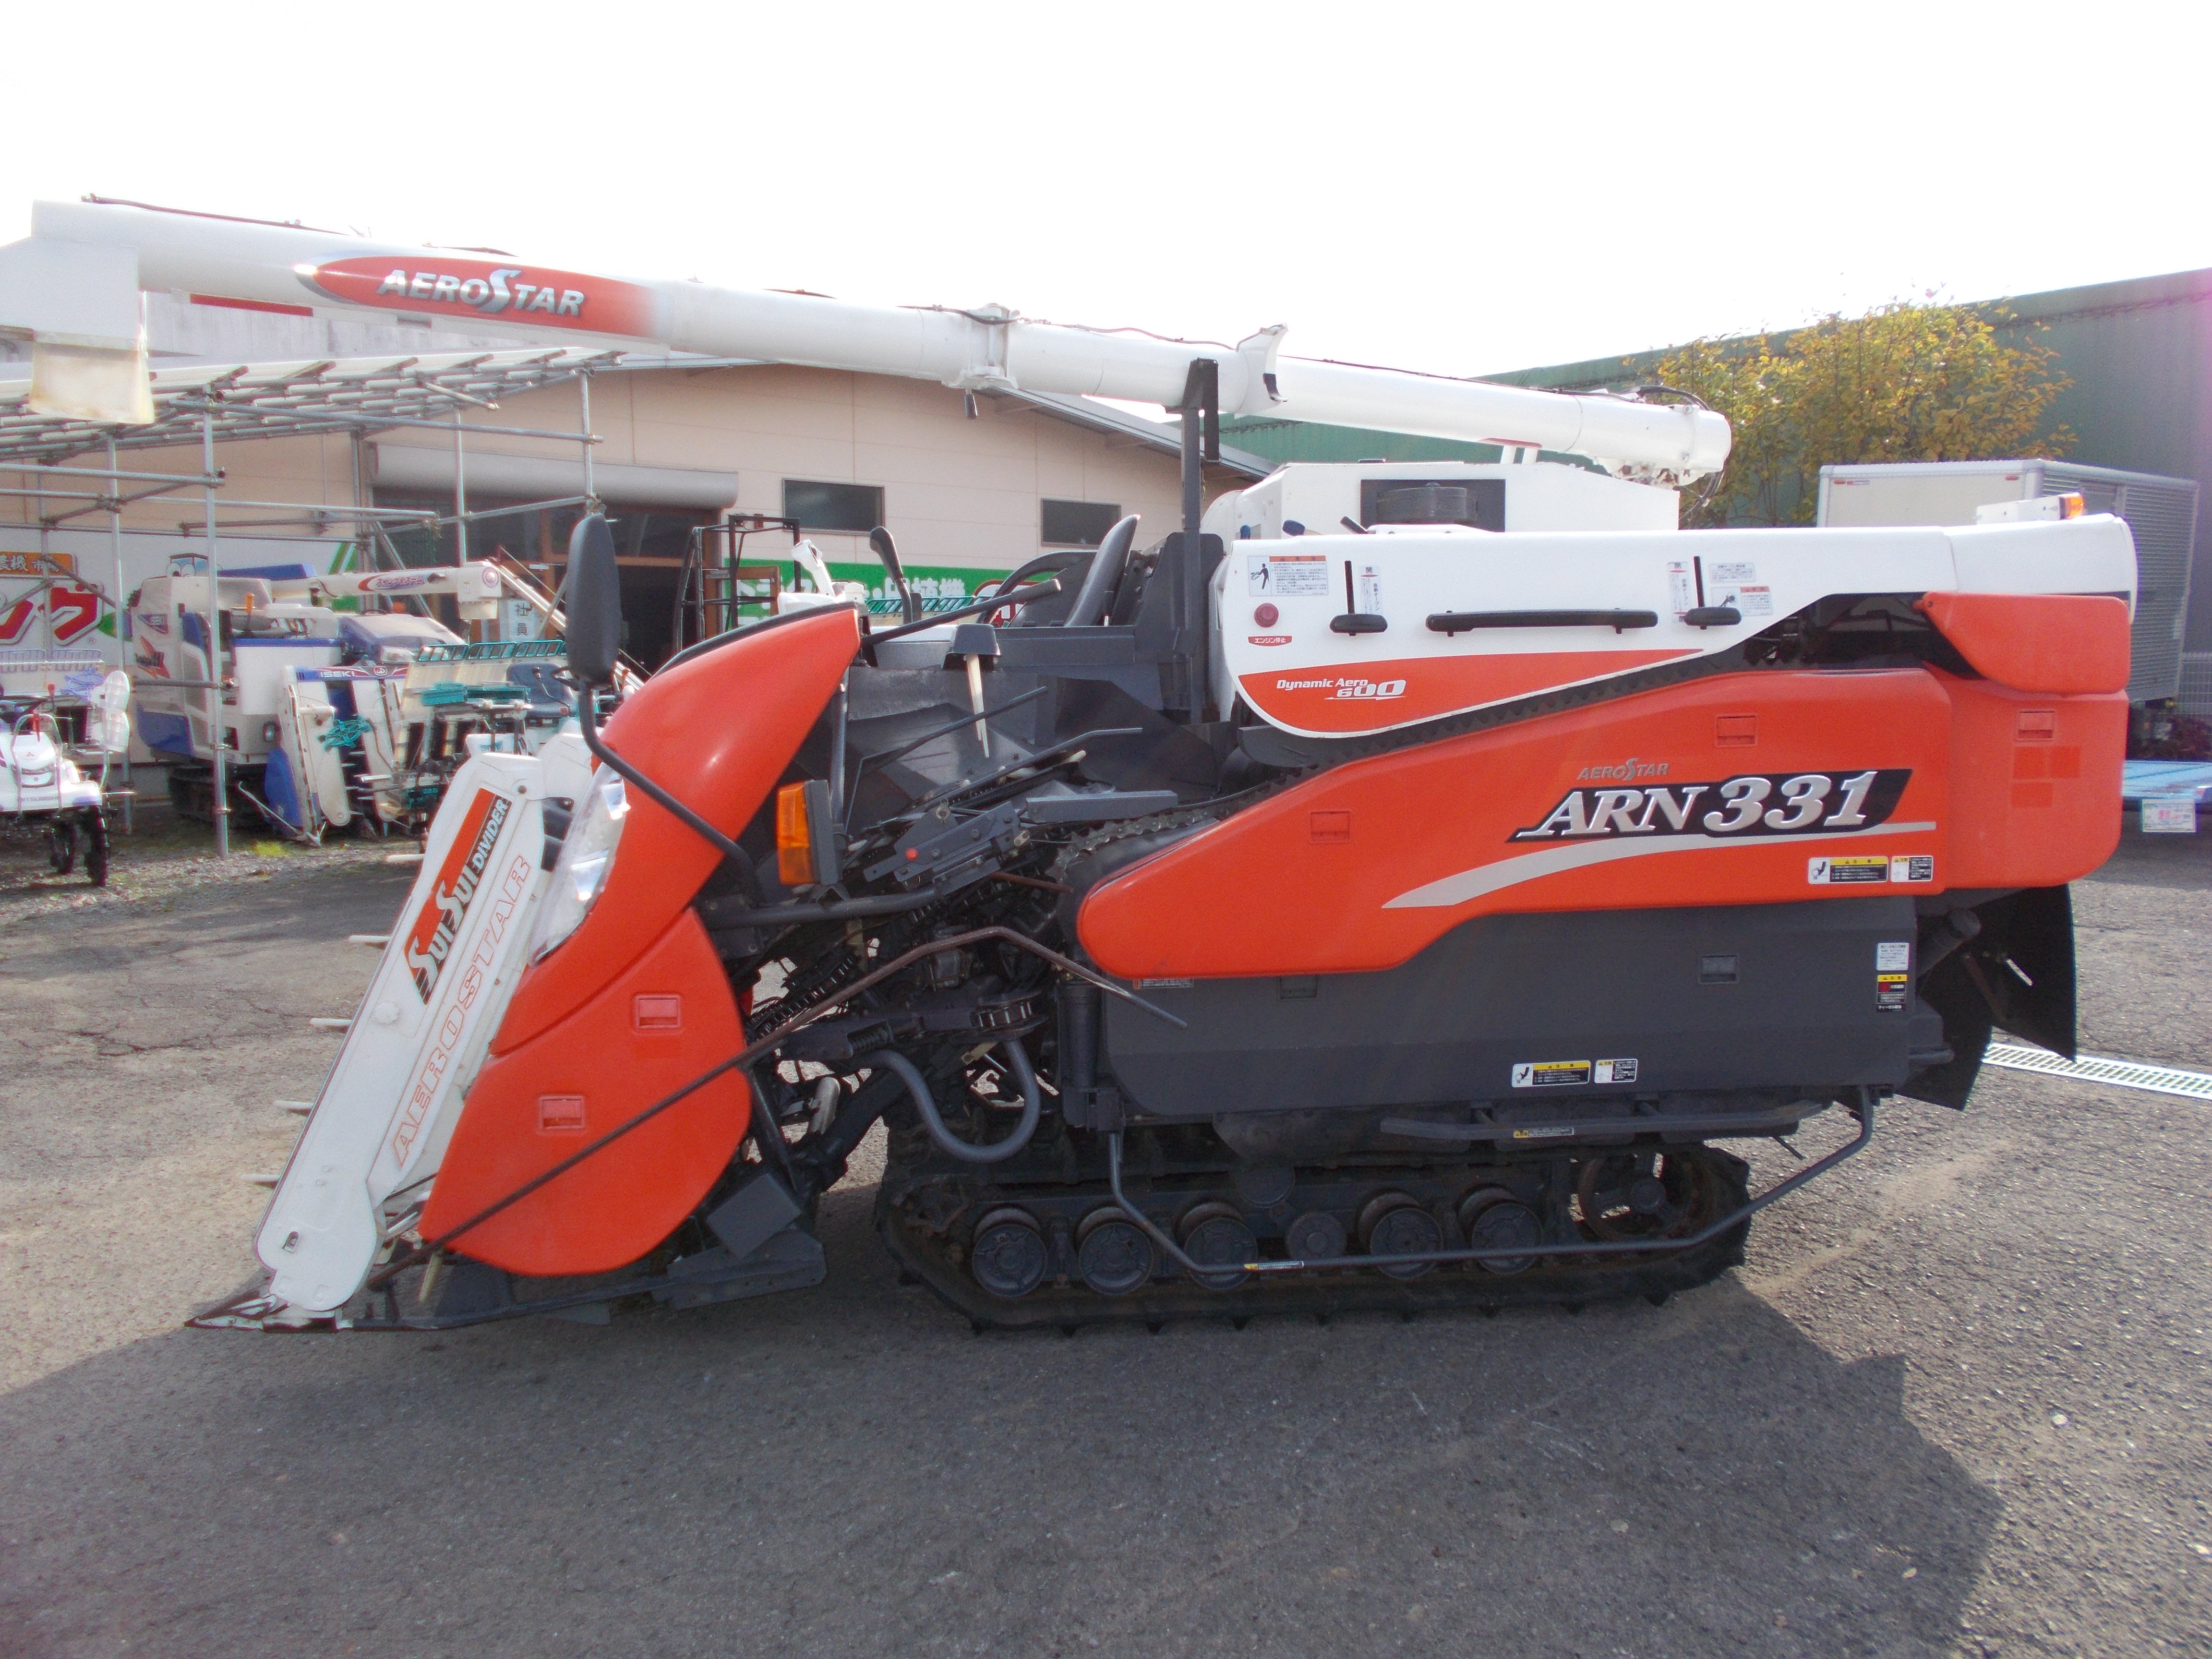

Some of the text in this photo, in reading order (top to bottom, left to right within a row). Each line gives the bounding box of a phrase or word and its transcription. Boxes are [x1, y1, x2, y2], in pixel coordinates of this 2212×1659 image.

[377, 269, 585, 316] AEROSTAR
[1276, 678, 1368, 690] Dynamic Aero
[1336, 680, 1406, 697] 600
[1577, 758, 1669, 781] AEROSTAR
[1516, 771, 1878, 838] ARN 331
[472, 798, 508, 870] DIVIDER
[393, 855, 530, 1166] AEROSTAR
